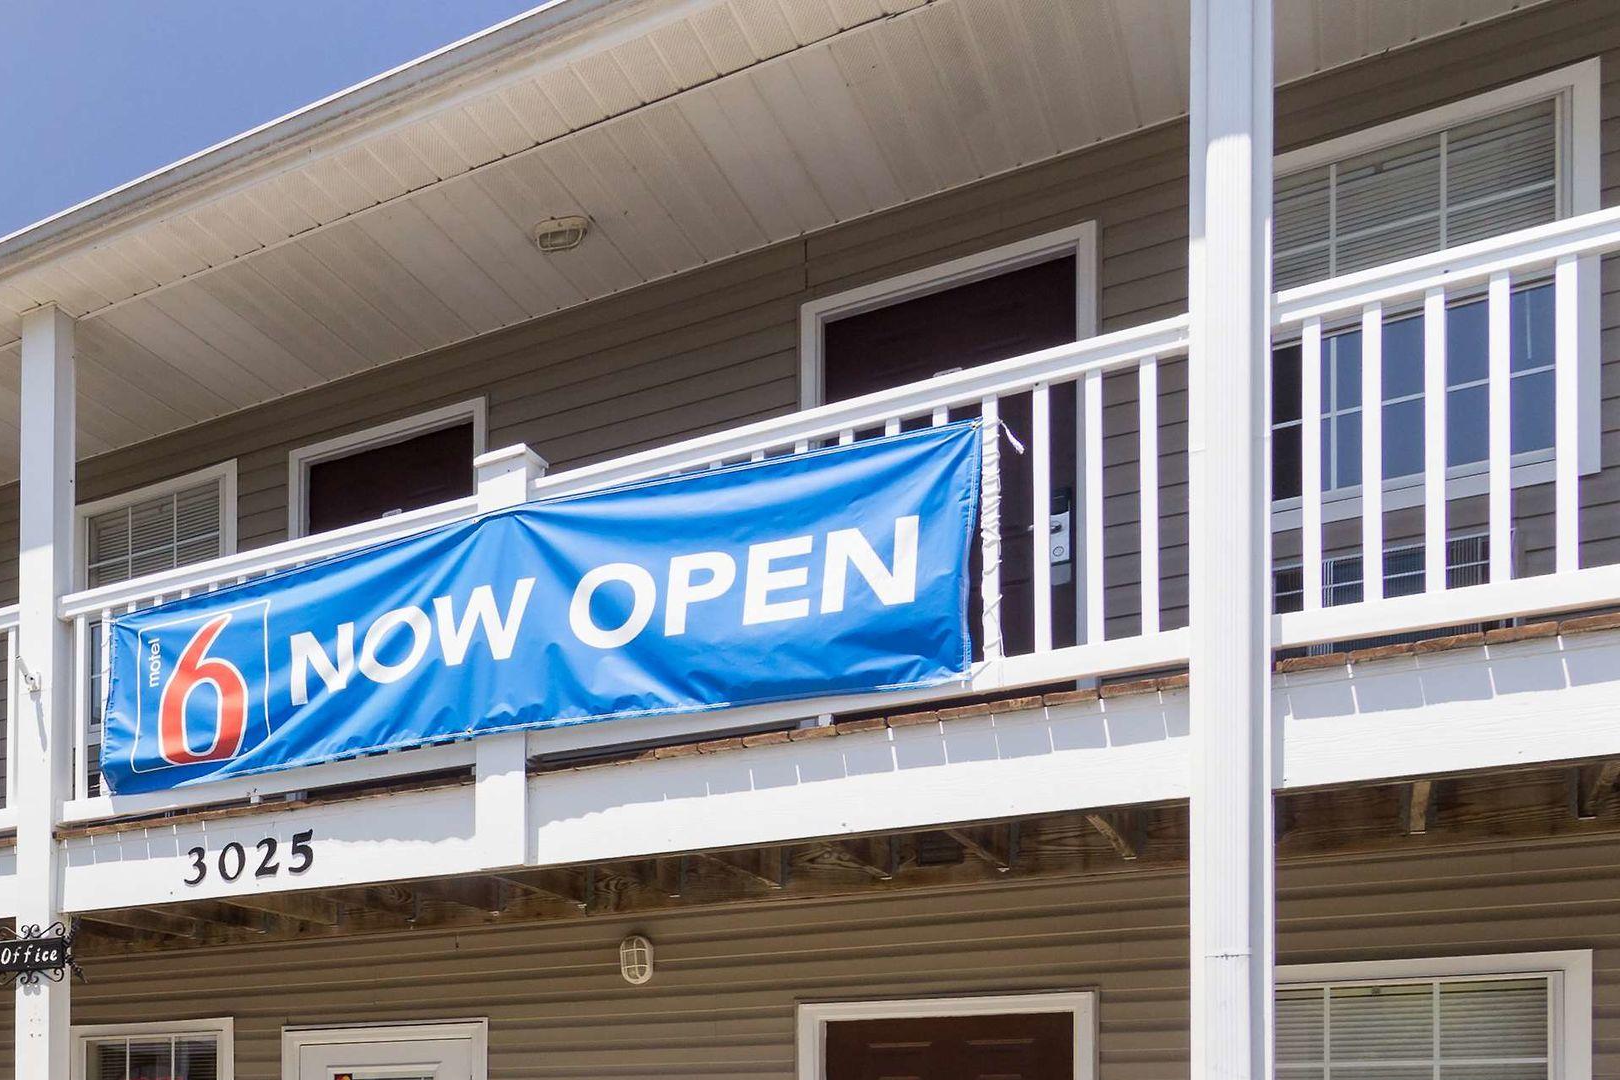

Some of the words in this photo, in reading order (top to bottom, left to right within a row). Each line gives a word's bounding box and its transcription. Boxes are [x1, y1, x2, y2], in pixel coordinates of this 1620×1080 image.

[290, 578, 536, 706] NOW
[568, 514, 920, 649] OPEN
[148, 637, 161, 688] motel
[158, 612, 249, 766] 6
[183, 828, 315, 886] 3025
[0, 944, 58, 965] Office
